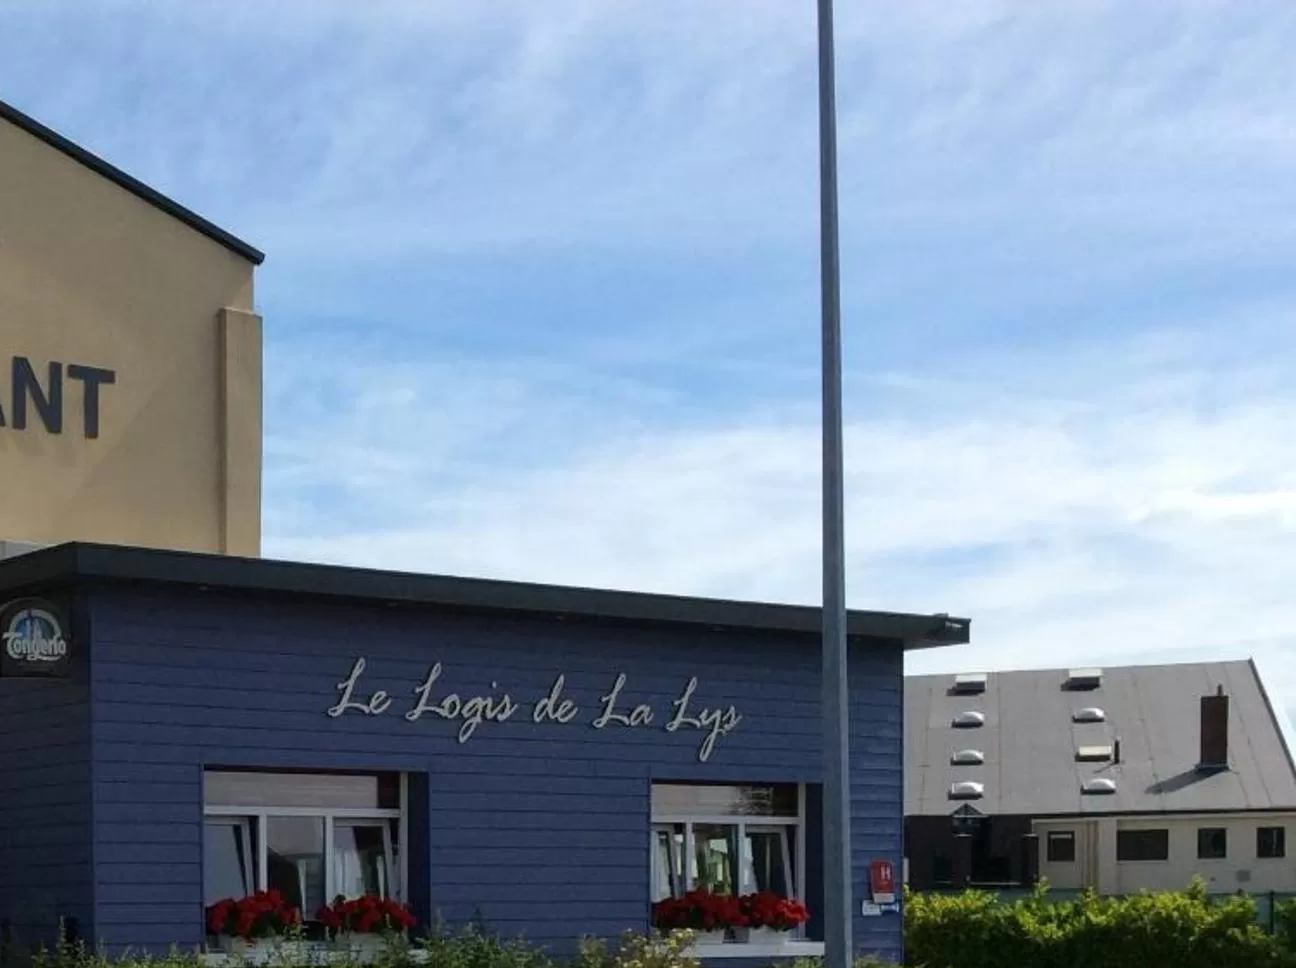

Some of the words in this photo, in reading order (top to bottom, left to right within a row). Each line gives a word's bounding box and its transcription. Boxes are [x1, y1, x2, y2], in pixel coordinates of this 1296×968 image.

[327, 657, 391, 718] Le
[405, 661, 517, 744] Logis
[533, 674, 578, 724] de
[592, 673, 654, 730] La
[665, 677, 742, 762] Lys
